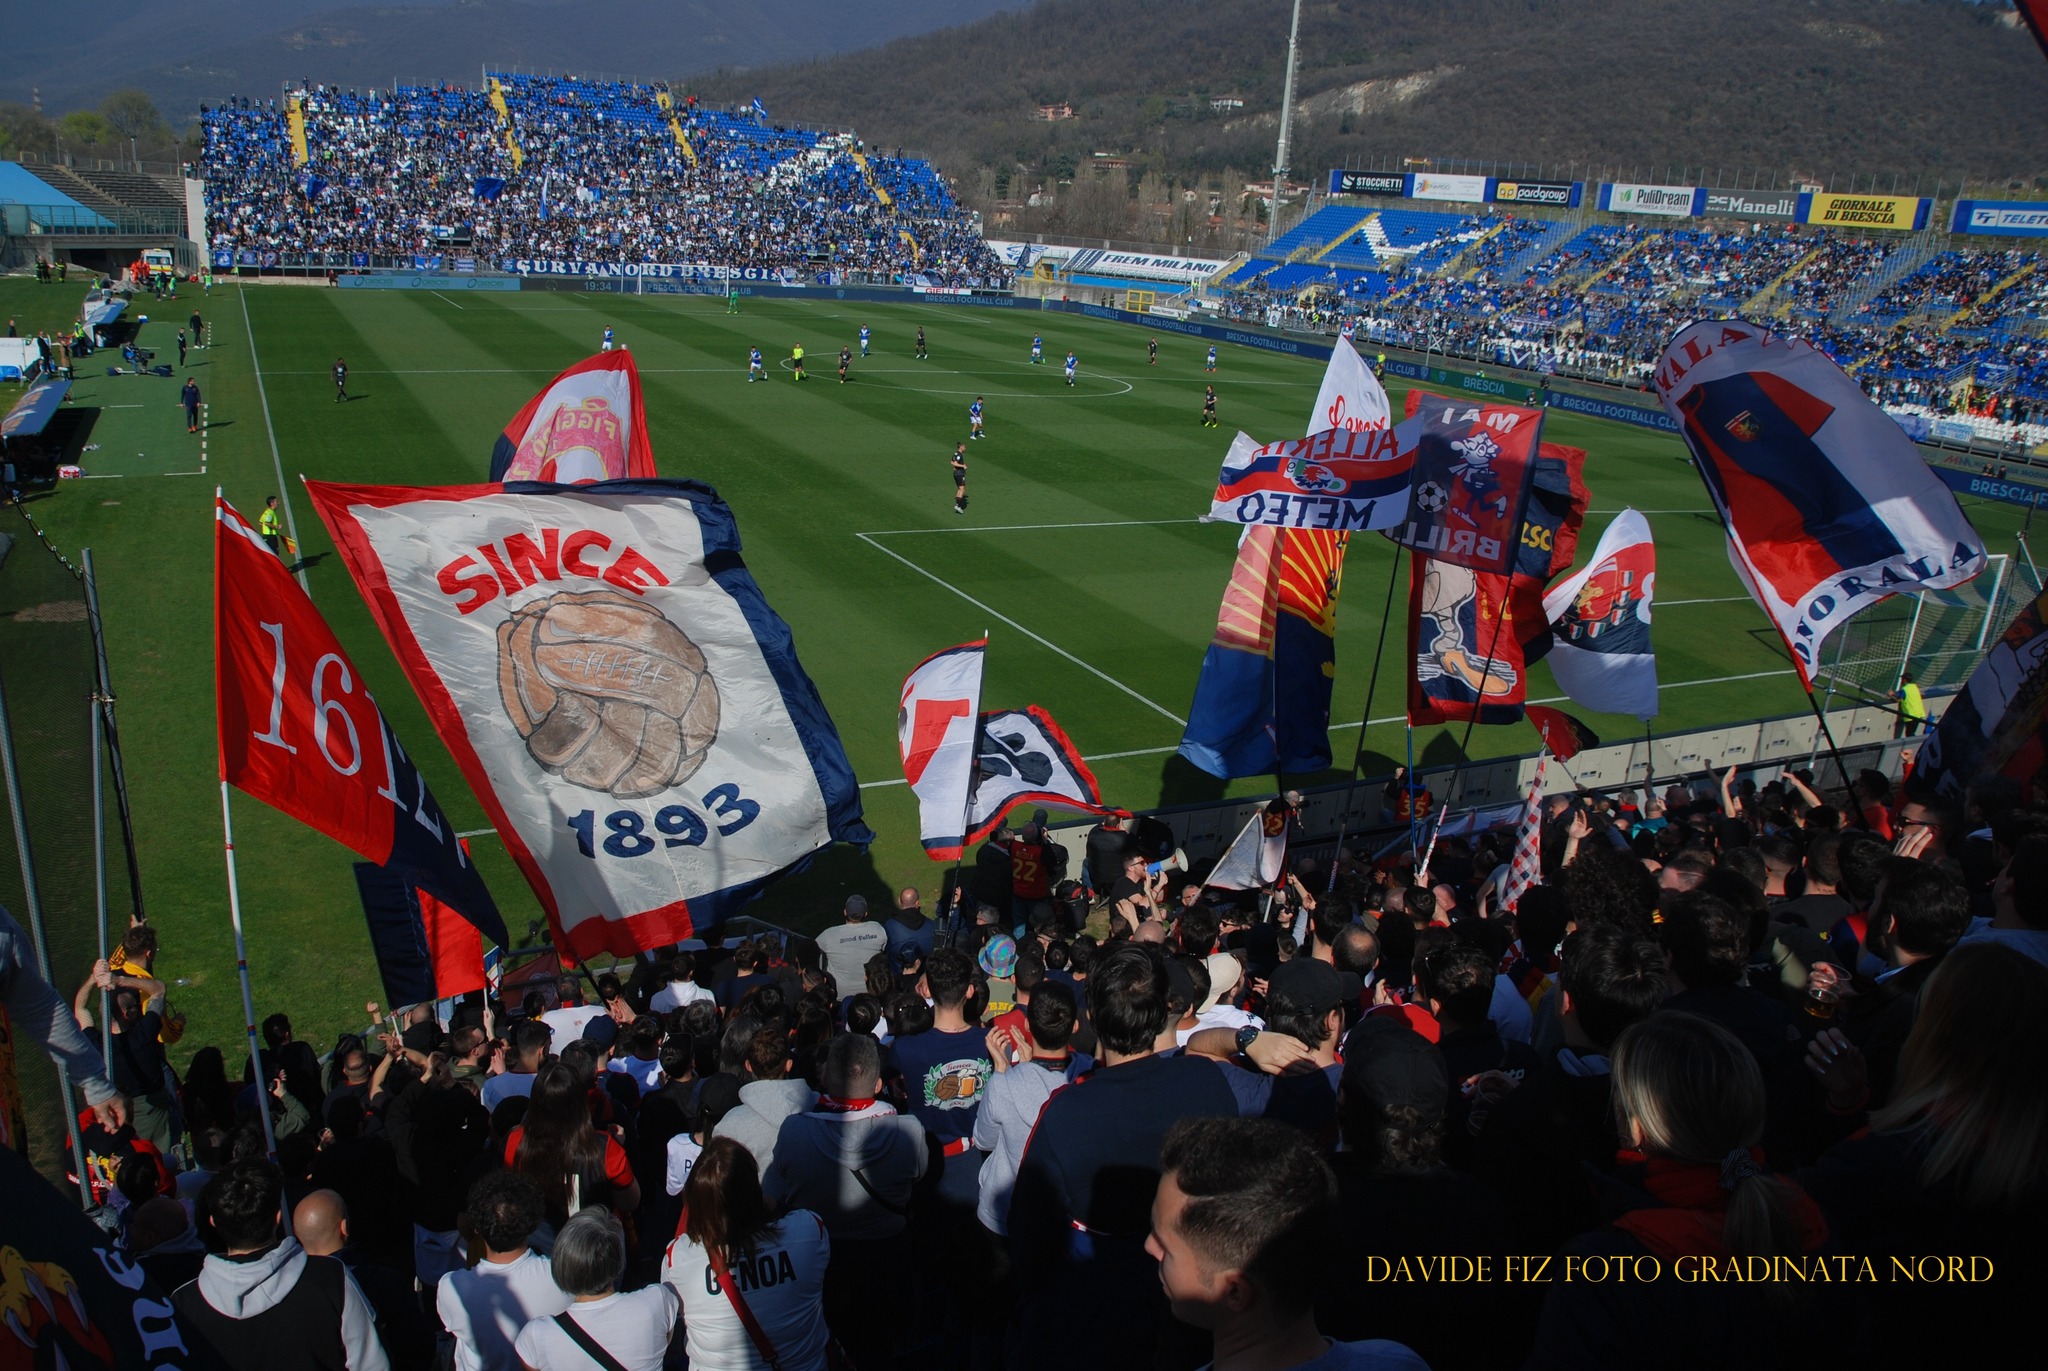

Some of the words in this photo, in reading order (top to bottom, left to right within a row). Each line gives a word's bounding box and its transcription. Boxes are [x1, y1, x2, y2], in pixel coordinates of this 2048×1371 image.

[1356, 176, 1403, 190] STOCCHETTI
[1517, 188, 1567, 203] pardgroup
[1636, 188, 1690, 206] PuliDream
[1728, 197, 1794, 216] Manelli
[1829, 199, 1896, 213] GIORNALE
[1824, 210, 1837, 220] DI
[1839, 211, 1896, 224] BRESCIA
[2002, 213, 2048, 225] TELET
[609, 262, 673, 278] NORD
[1102, 254, 1150, 266] FREM
[1151, 259, 1218, 274] MILANO
[584, 281, 612, 291] 19:34
[925, 295, 955, 303] BRESCIA
[956, 296, 994, 305] FOOTBALL
[995, 298, 1014, 306] CLUB
[1141, 316, 1162, 328] BRESCIA
[1162, 318, 1188, 332] FOOTBALL
[1188, 325, 1203, 335] CLUB
[1226, 331, 1250, 345] BRESCIA
[1250, 336, 1280, 351] FOOTBALL
[1281, 341, 1298, 353] CLUB
[1396, 364, 1415, 376] CLUB
[1463, 376, 1505, 395] BRESCIA
[1563, 397, 1602, 414] BRESCIA
[1603, 403, 1656, 426] FOOTBALL
[1970, 478, 2034, 502] BRESCIA
[436, 528, 671, 616] SINCE
[1792, 541, 1980, 666] ONORALA
[567, 782, 761, 860] 1893
[1012, 857, 1038, 883] 22
